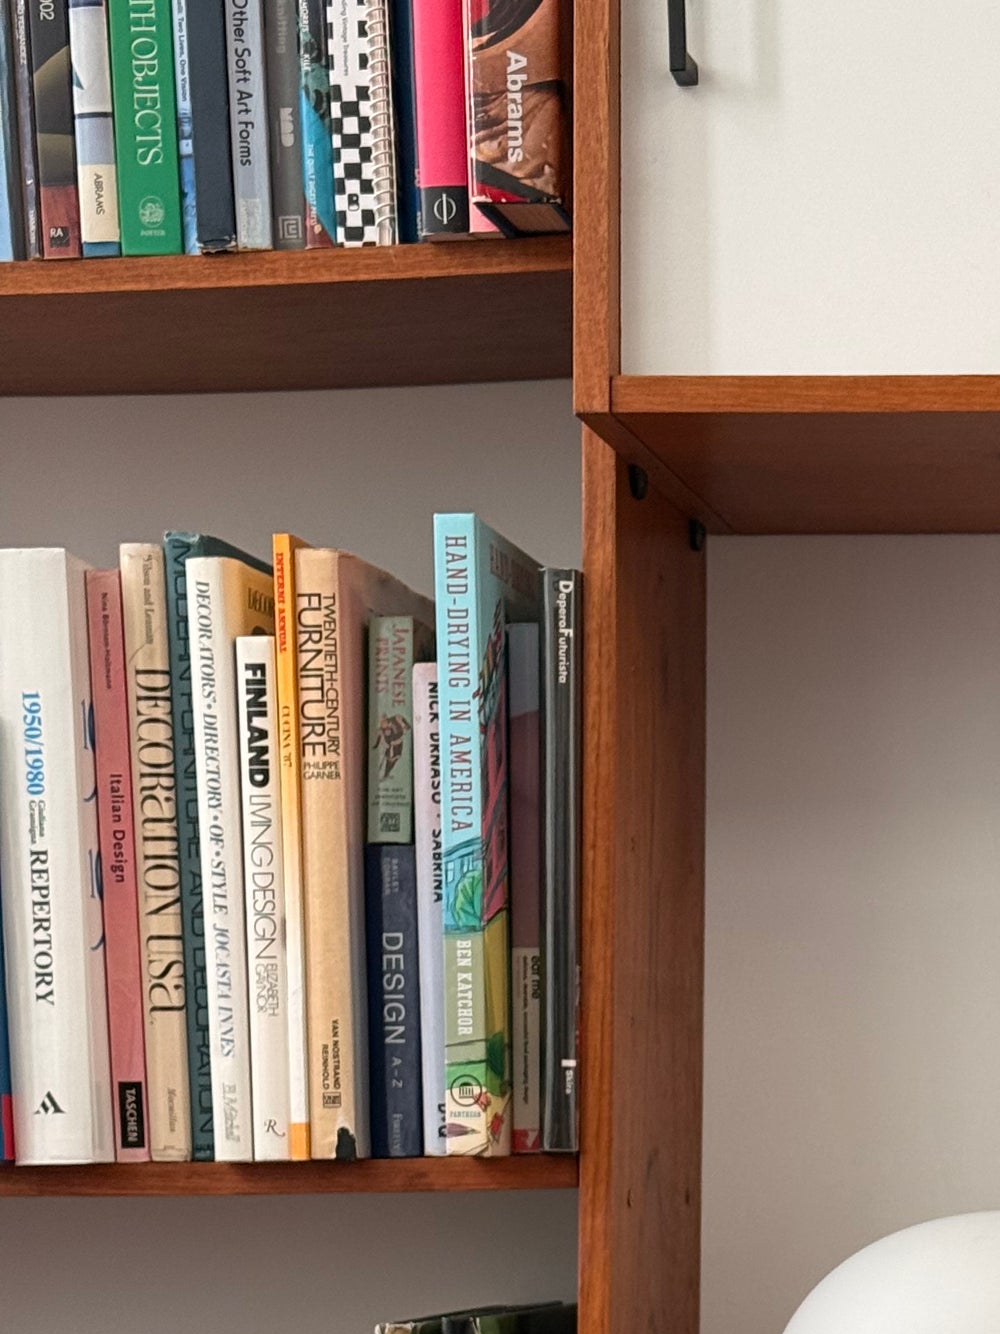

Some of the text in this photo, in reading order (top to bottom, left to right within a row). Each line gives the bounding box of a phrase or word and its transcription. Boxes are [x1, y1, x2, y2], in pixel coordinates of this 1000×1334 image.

[131, 38, 163, 166] OBJECTS
[180, 60, 188, 77] One
[181, 77, 189, 102] Vision
[232, 0, 255, 166] Other Soft Art Forms
[506, 50, 528, 163] Abrams
[94, 173, 105, 215] ABRAMS
[50, 228, 63, 239] RA
[275, 552, 288, 655] INTERNI ANNUAL
[297, 593, 327, 758] FURNITURE
[323, 593, 341, 757] TWENTIETH-CENTURY
[375, 637, 390, 694] PRINTS
[392, 625, 410, 707] JAPANESE
[429, 681, 441, 723] NICK
[445, 535, 474, 833] HAND-DRYING IN AMERICA
[22, 691, 45, 796] 1950/1980
[203, 713, 222, 811] DIRECTORY
[110, 774, 127, 884] Italian Design
[210, 825, 225, 848] OF
[245, 663, 277, 960] FINLAND LIVING DESIGN
[211, 858, 229, 916] STYLE
[431, 829, 443, 904] SABRINA
[30, 850, 54, 1006] REPERTORY
[213, 923, 232, 1000] JOCASTA
[268, 963, 280, 1017] ELIZABETH
[382, 932, 406, 1044] DESIGN
[456, 940, 474, 1037] BEN KATCHOR
[218, 1006, 236, 1060] INNES
[332, 1018, 340, 1039] VAN
[332, 1040, 342, 1090] NOSTRAND
[322, 1044, 331, 1090] REINHOLD
[565, 1070, 575, 1095] Skira
[126, 1088, 138, 1141] TASCHEN
